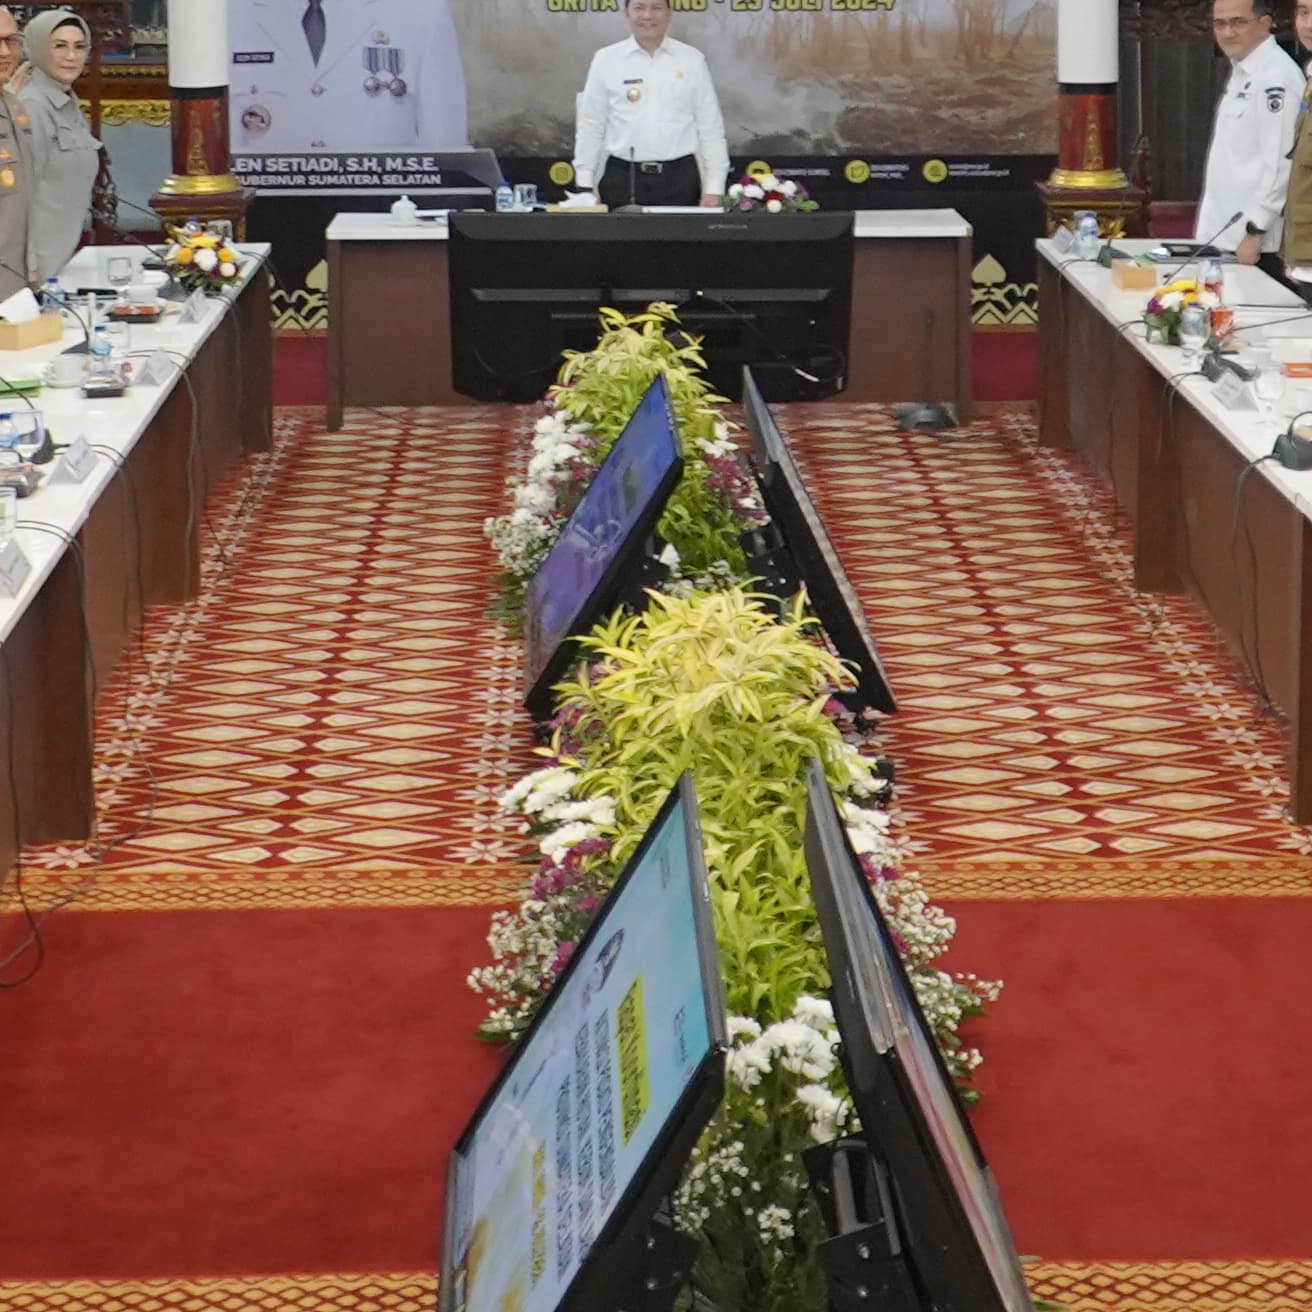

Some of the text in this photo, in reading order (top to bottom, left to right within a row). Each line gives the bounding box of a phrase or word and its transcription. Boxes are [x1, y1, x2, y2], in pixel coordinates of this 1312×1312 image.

[264, 157, 344, 174] SETIADI,
[235, 173, 442, 186] UBERNUR SUMATERA SELATAN
